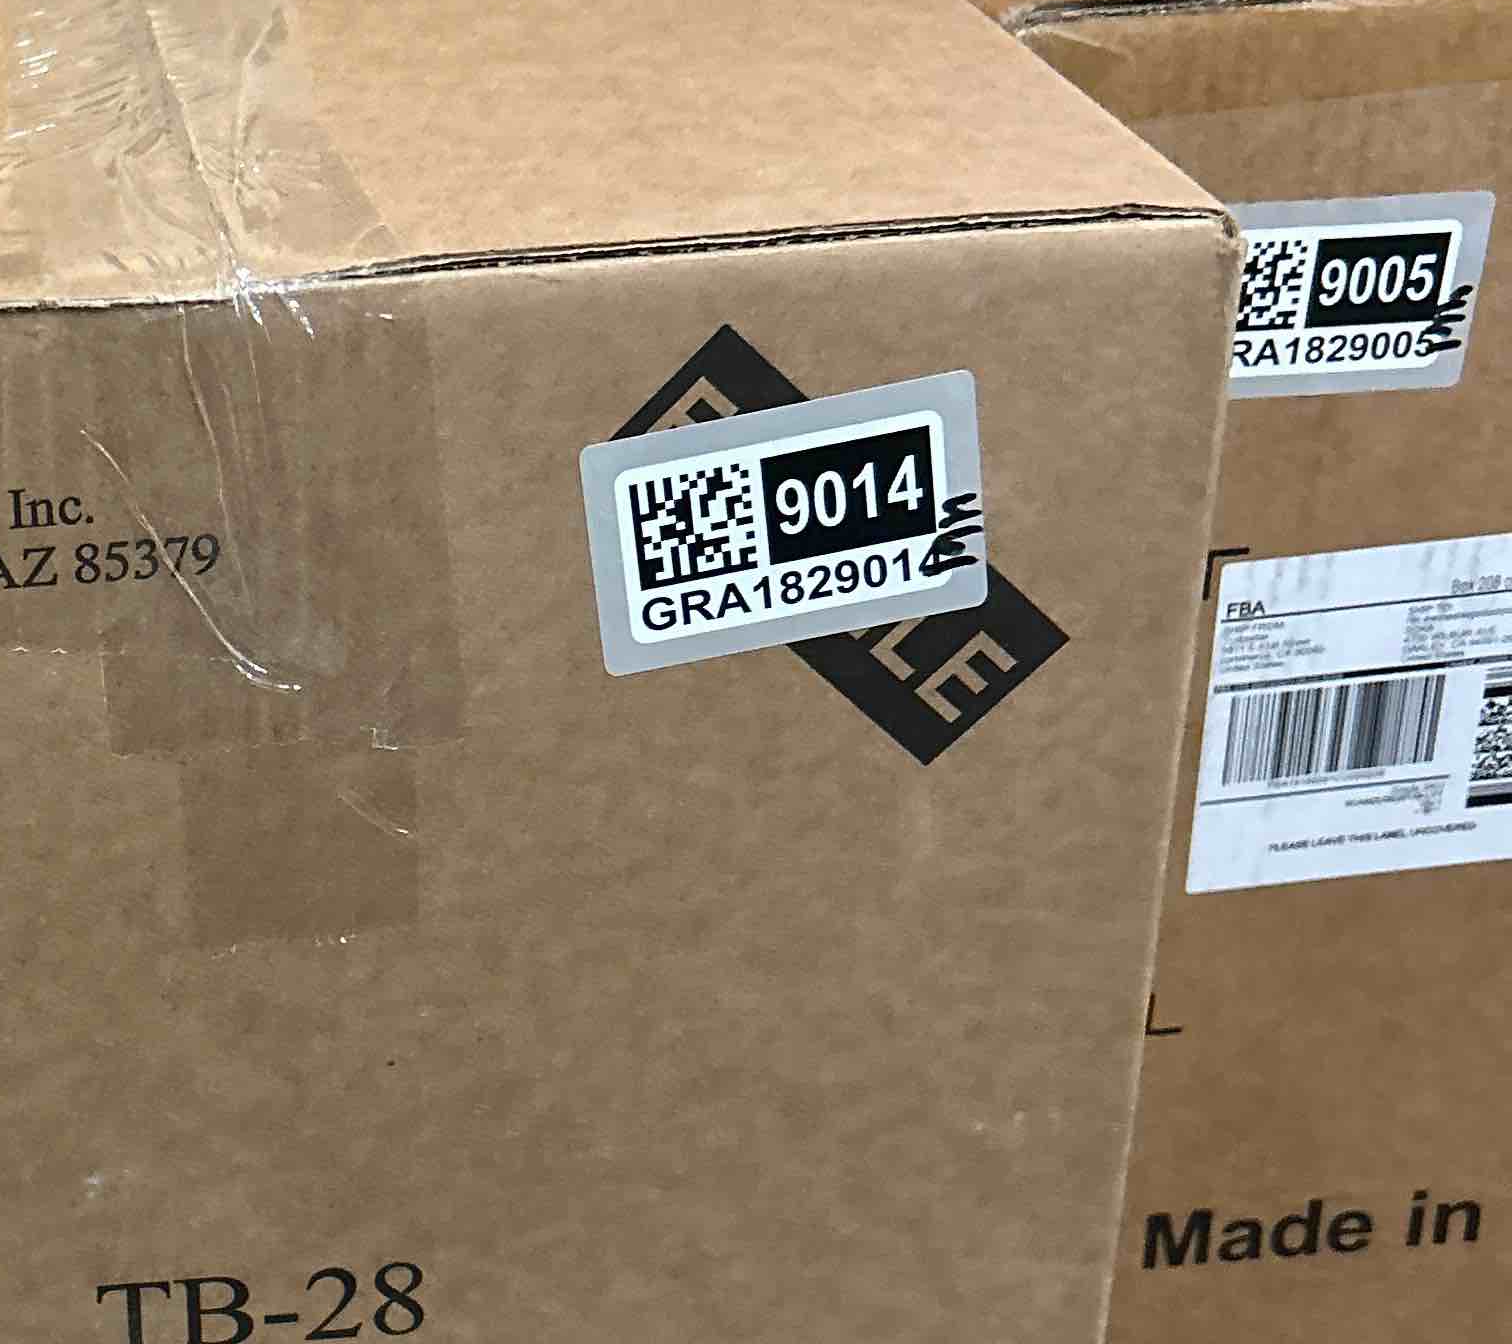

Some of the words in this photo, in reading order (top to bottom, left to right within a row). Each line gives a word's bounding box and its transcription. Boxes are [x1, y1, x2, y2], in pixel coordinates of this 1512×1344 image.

[1318, 253, 1437, 307] 9005
[1232, 329, 1436, 368] RA1829005
[8, 488, 94, 530] Inc.
[775, 454, 923, 535] 9014
[74, 533, 220, 585] 85379
[1226, 600, 1265, 620] FBA
[1142, 1199, 1374, 1270] Made
[1405, 1190, 1483, 1247] in
